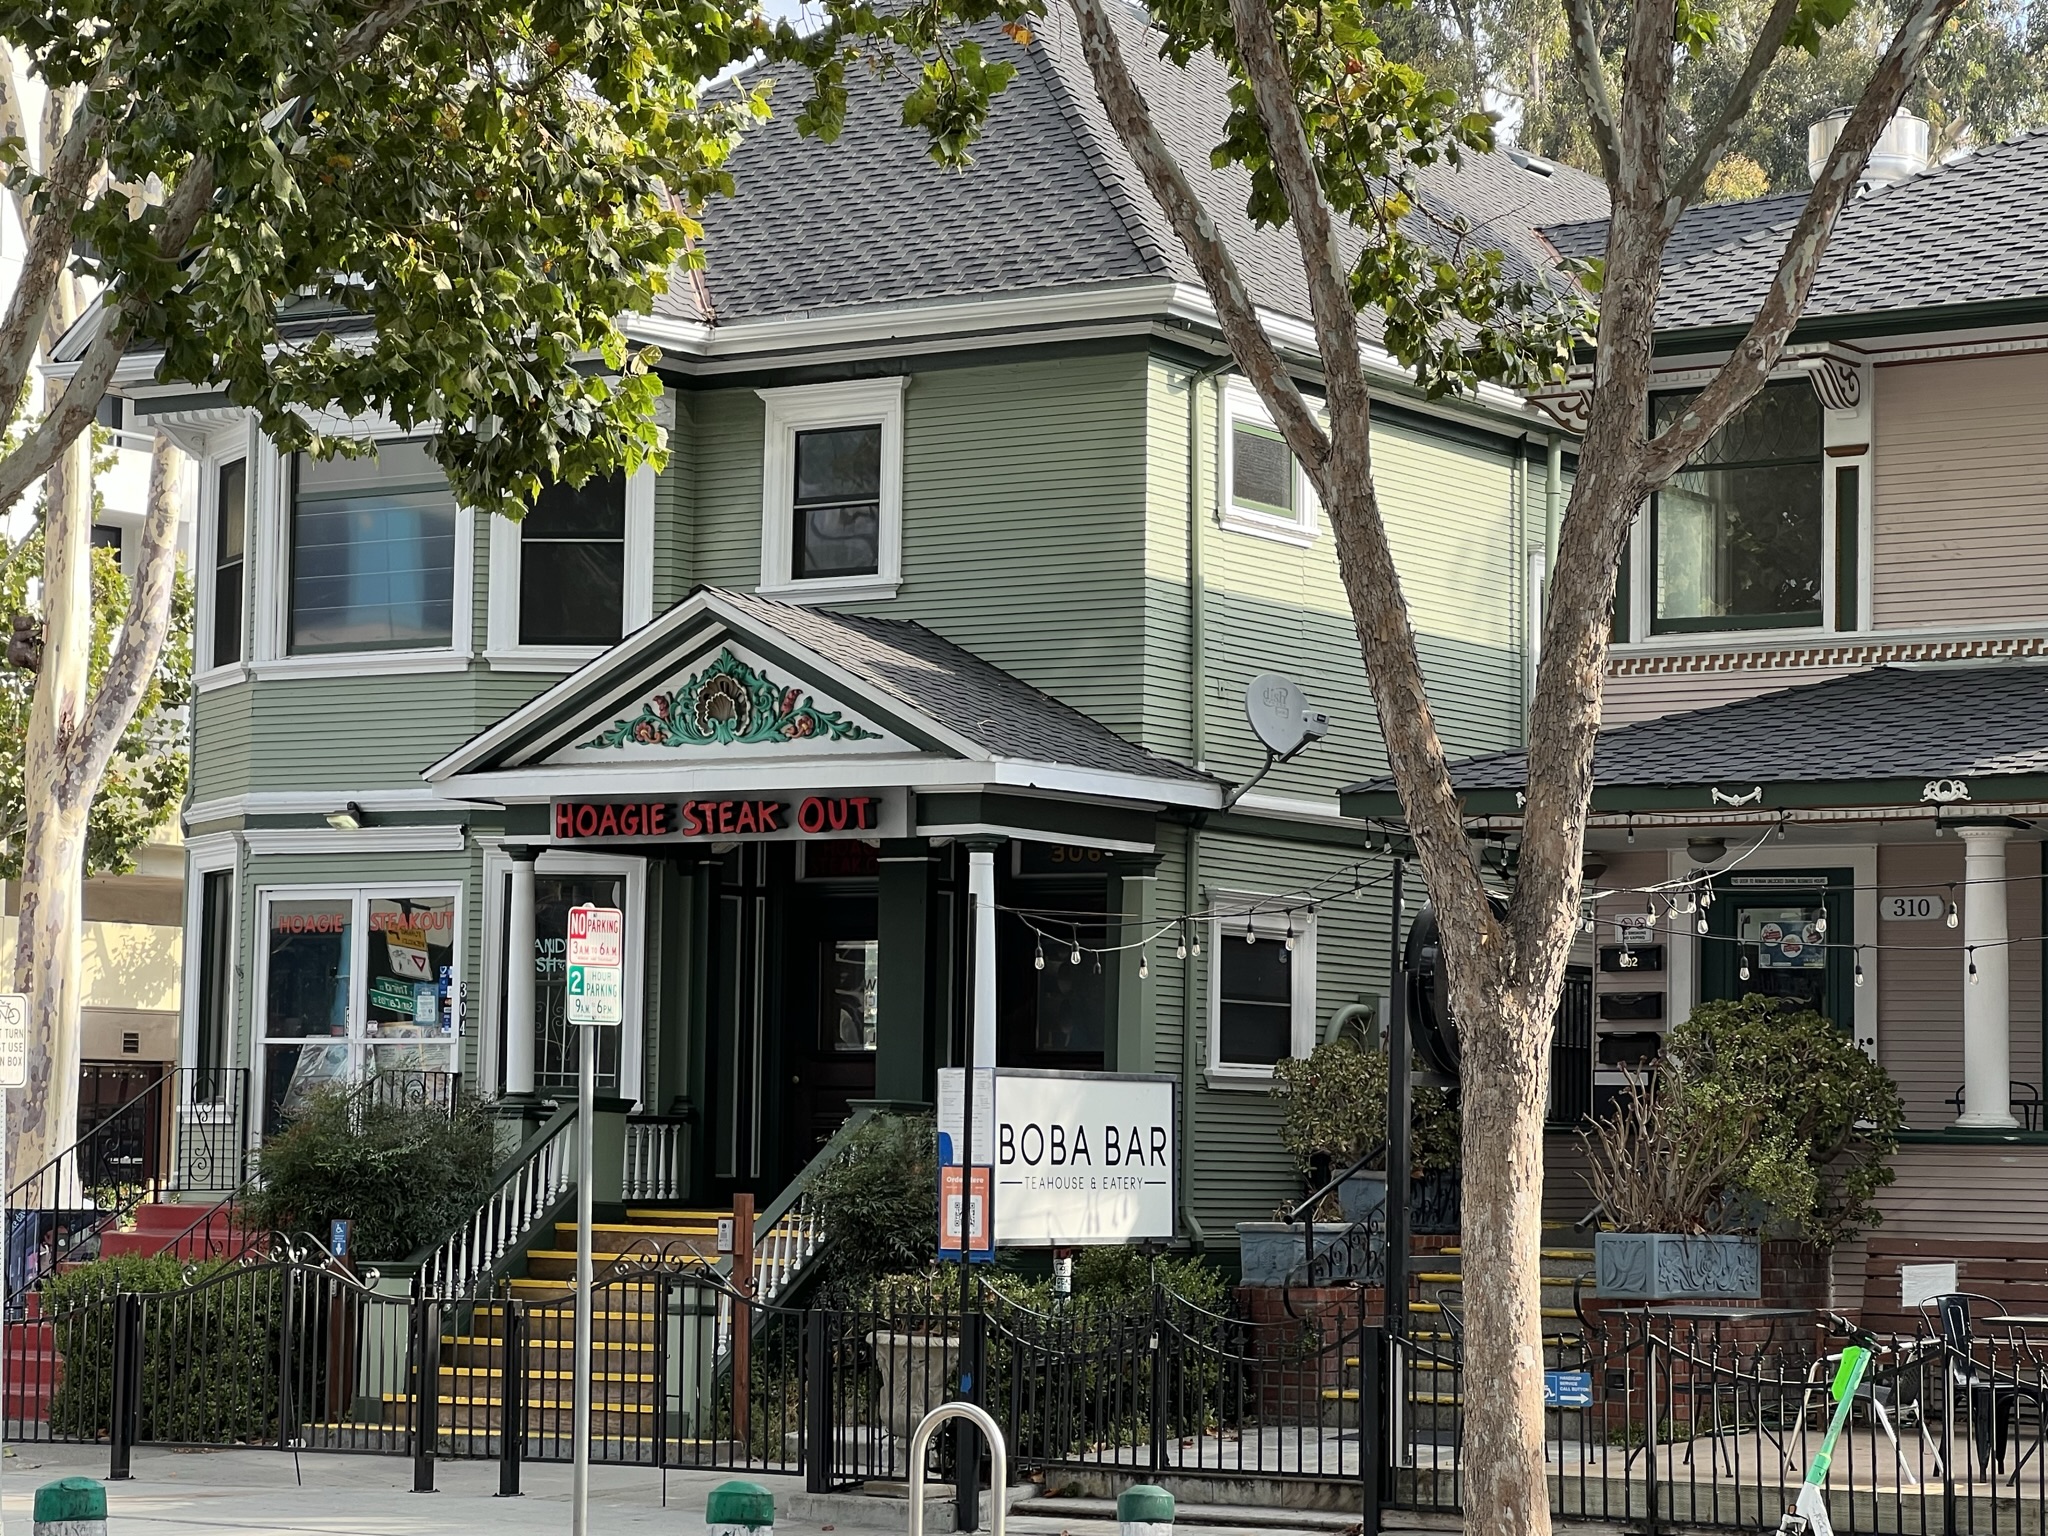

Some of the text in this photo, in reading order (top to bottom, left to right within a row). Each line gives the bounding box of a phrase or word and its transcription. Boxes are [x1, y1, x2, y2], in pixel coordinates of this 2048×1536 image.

[1263, 687, 1288, 705] dish
[555, 796, 870, 838] HOAGIE STEAK OUT
[1893, 899, 1930, 917] 310
[279, 911, 454, 934] HOAGIE STEAKOUT
[571, 913, 618, 936] NO PARKING
[571, 971, 612, 992] 2 HOUR
[586, 983, 618, 998] PARKING
[5, 1028, 24, 1039] TURN
[8, 1042, 23, 1053] USE
[7, 1056, 22, 1067] BOX
[999, 1123, 1167, 1166] BOBA BAR
[1025, 1176, 1143, 1190] TEAHOUSE & EATERY
